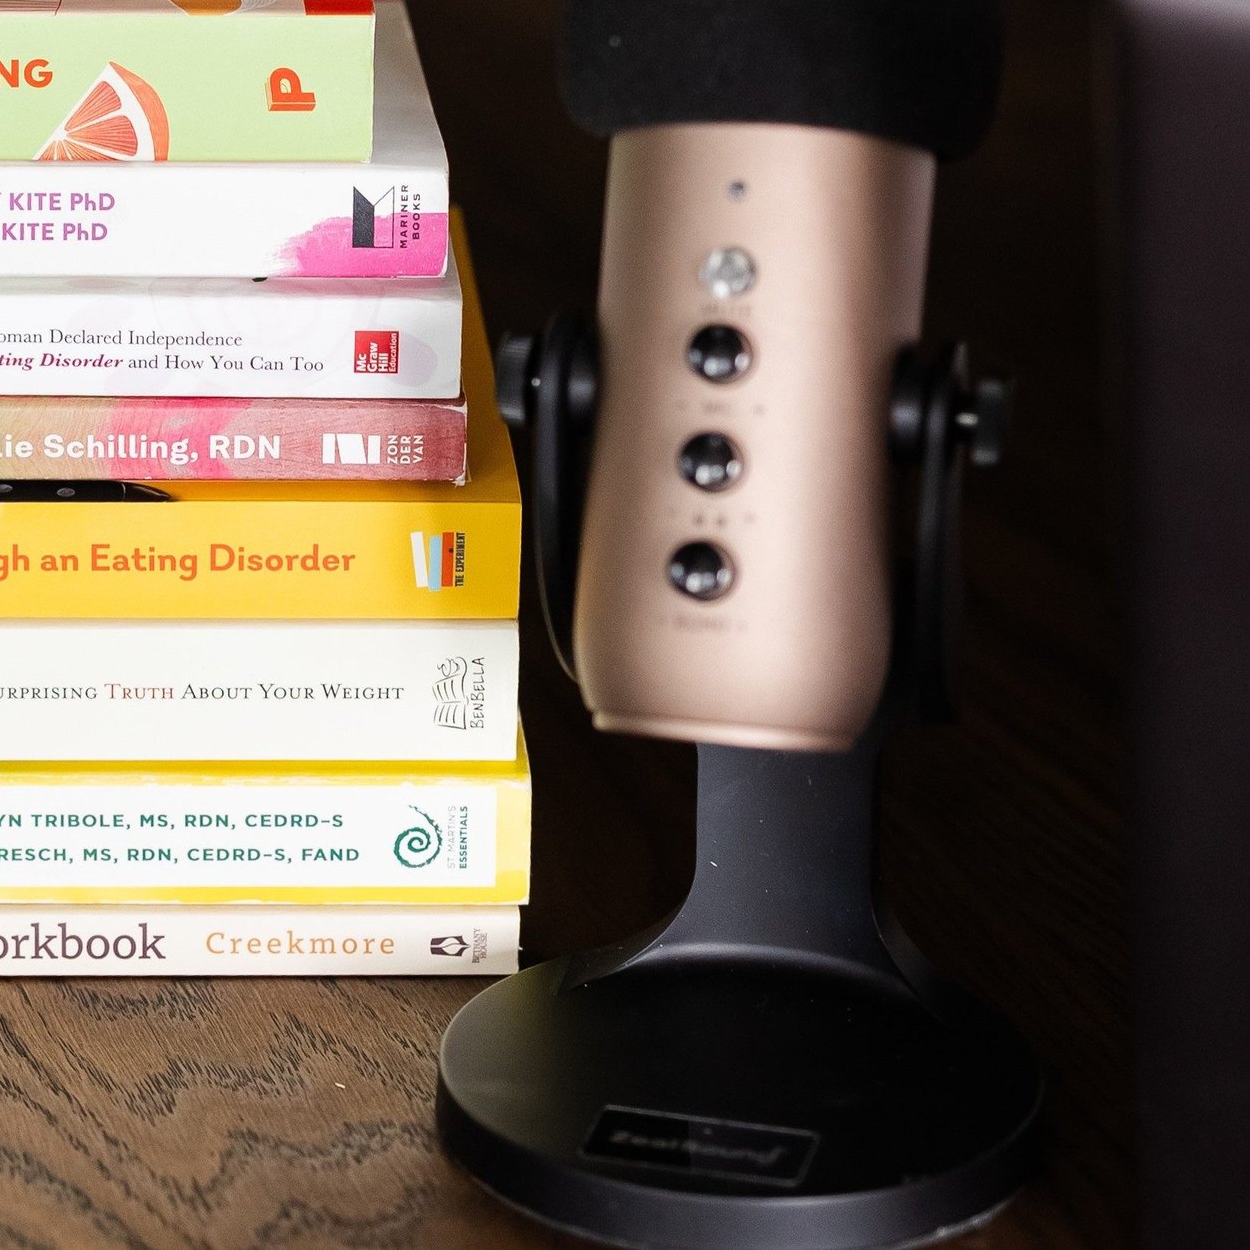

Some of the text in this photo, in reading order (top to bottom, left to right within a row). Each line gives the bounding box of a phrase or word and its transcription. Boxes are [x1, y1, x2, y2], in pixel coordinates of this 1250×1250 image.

[10, 193, 61, 211] KITE
[71, 193, 115, 211] PhD
[400, 184, 408, 248] MARINER
[412, 193, 421, 240] BOOKS
[2, 223, 54, 240] KITE
[63, 223, 107, 240] PhD
[50, 329, 122, 344] Declared
[129, 331, 242, 349] Independence
[388, 333, 397, 372] Education
[40, 353, 123, 367] Disorder
[129, 355, 158, 368] and
[166, 355, 201, 369] How
[210, 356, 243, 370] You
[250, 356, 283, 370] Can
[290, 357, 323, 371] Too
[356, 353, 367, 372] Mc
[367, 342, 378, 372] Graw
[379, 353, 389, 372] Hill
[44, 433, 198, 466] Schilling,
[209, 435, 281, 461] RDN
[387, 435, 398, 464] ZON
[400, 436, 411, 464] DER
[413, 435, 423, 464] VAN
[41, 555, 78, 571] an
[91, 544, 197, 581] Eating
[210, 544, 355, 571] Disorder
[455, 532, 465, 587] THE EXPERIMENT
[31, 815, 130, 829] TRIBOLE,
[140, 815, 174, 829] MS,
[185, 815, 235, 830] RDN,
[459, 806, 468, 869] ESSENTIALS
[84, 849, 117, 863] MS,
[128, 849, 177, 863] RDN,
[302, 849, 359, 861] FAND
[206, 930, 394, 954] Creekmore
